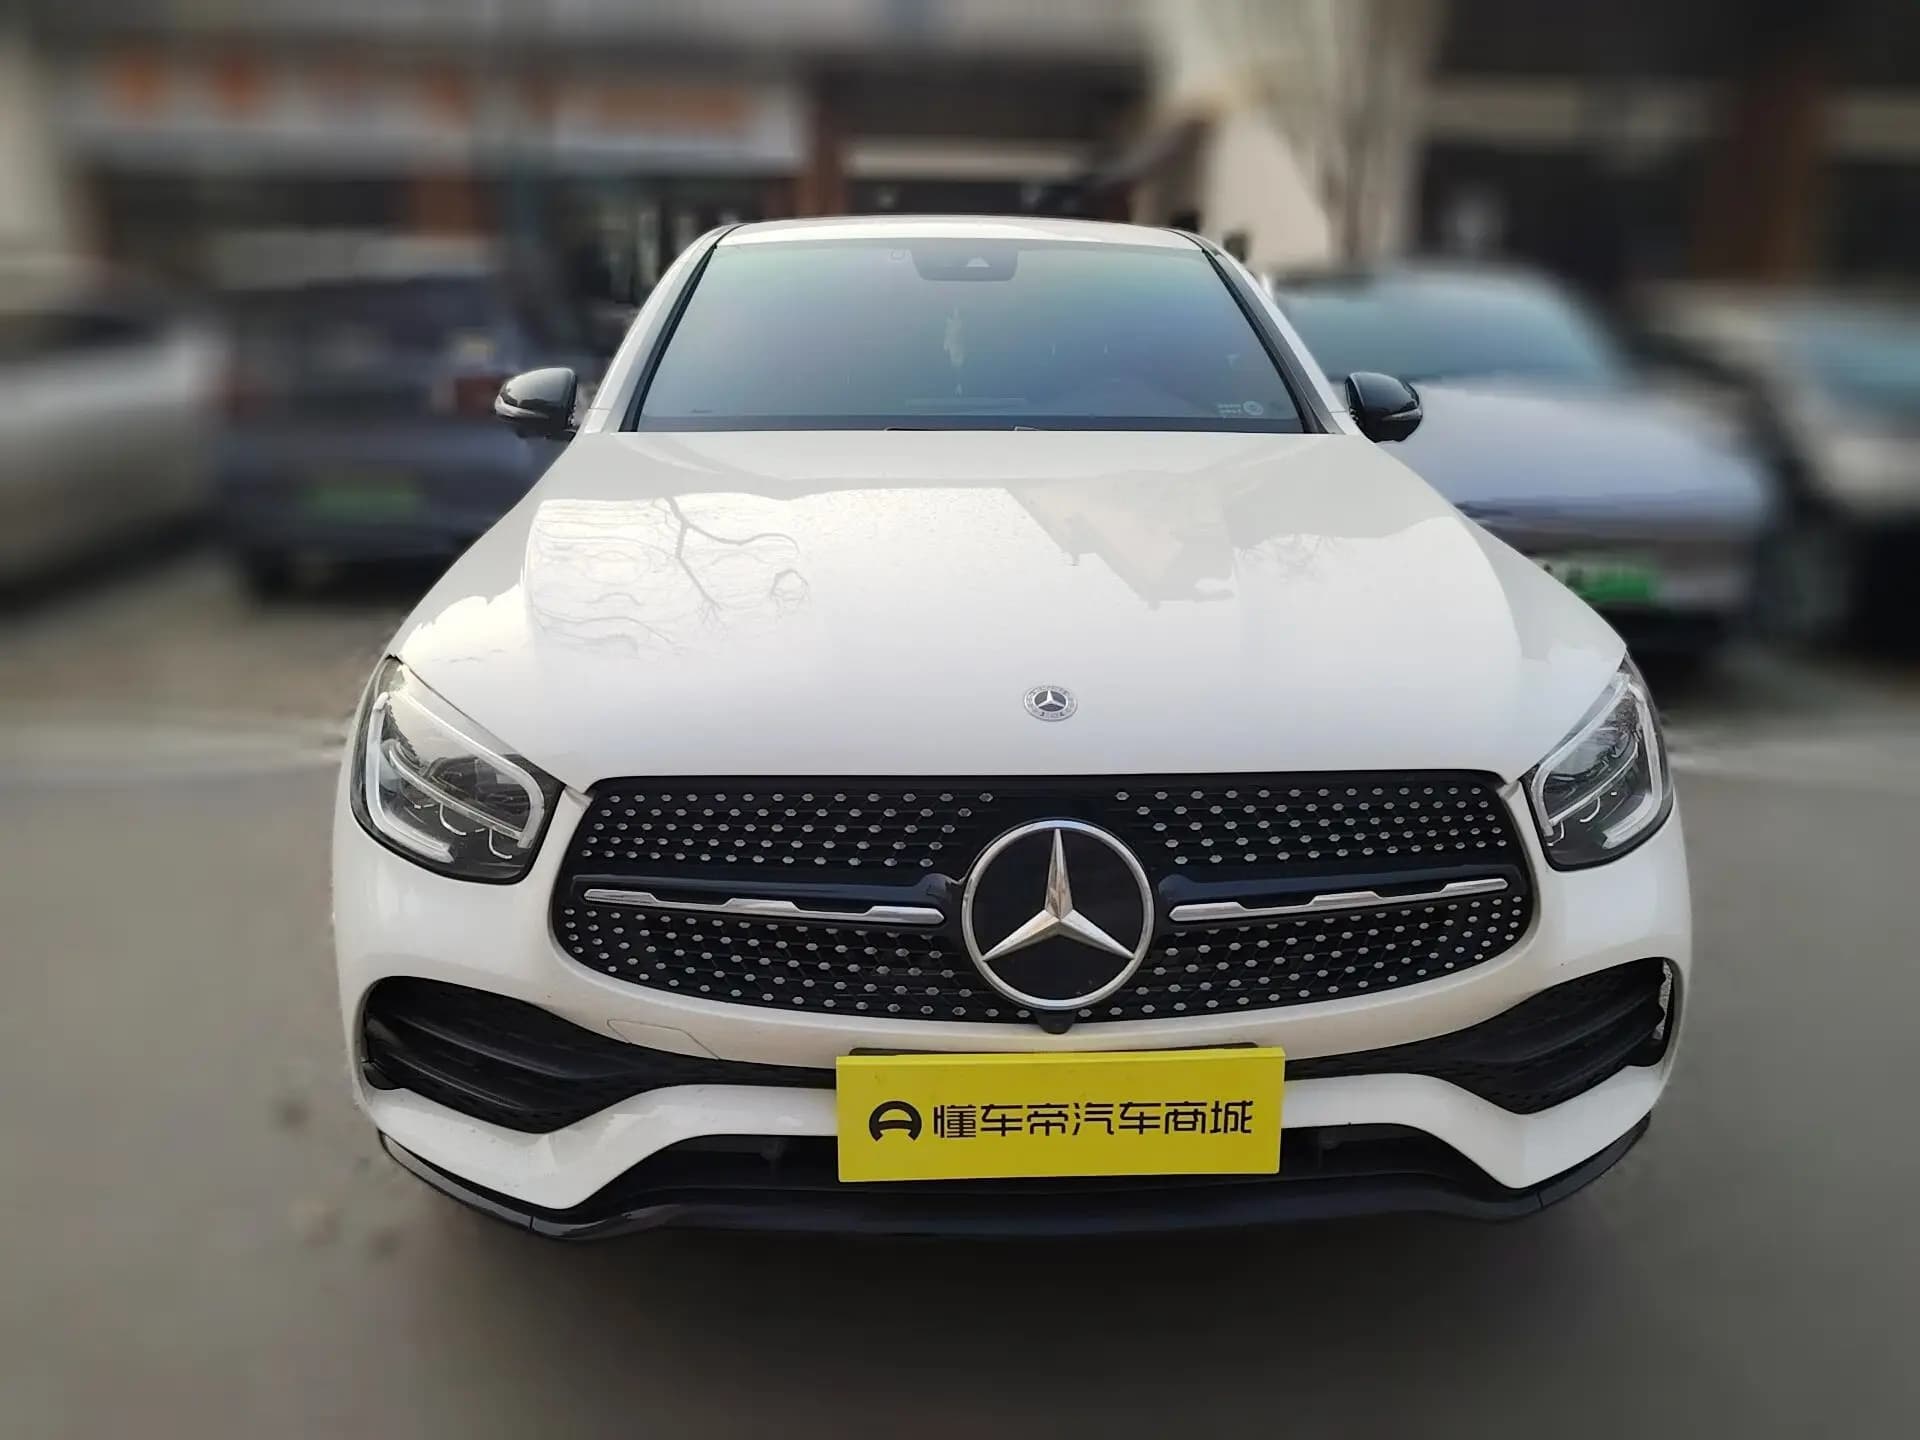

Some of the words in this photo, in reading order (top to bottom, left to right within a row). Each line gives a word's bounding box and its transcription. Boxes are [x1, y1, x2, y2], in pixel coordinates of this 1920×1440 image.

[932, 1100, 1254, 1139] 懂车帝汽车商城
